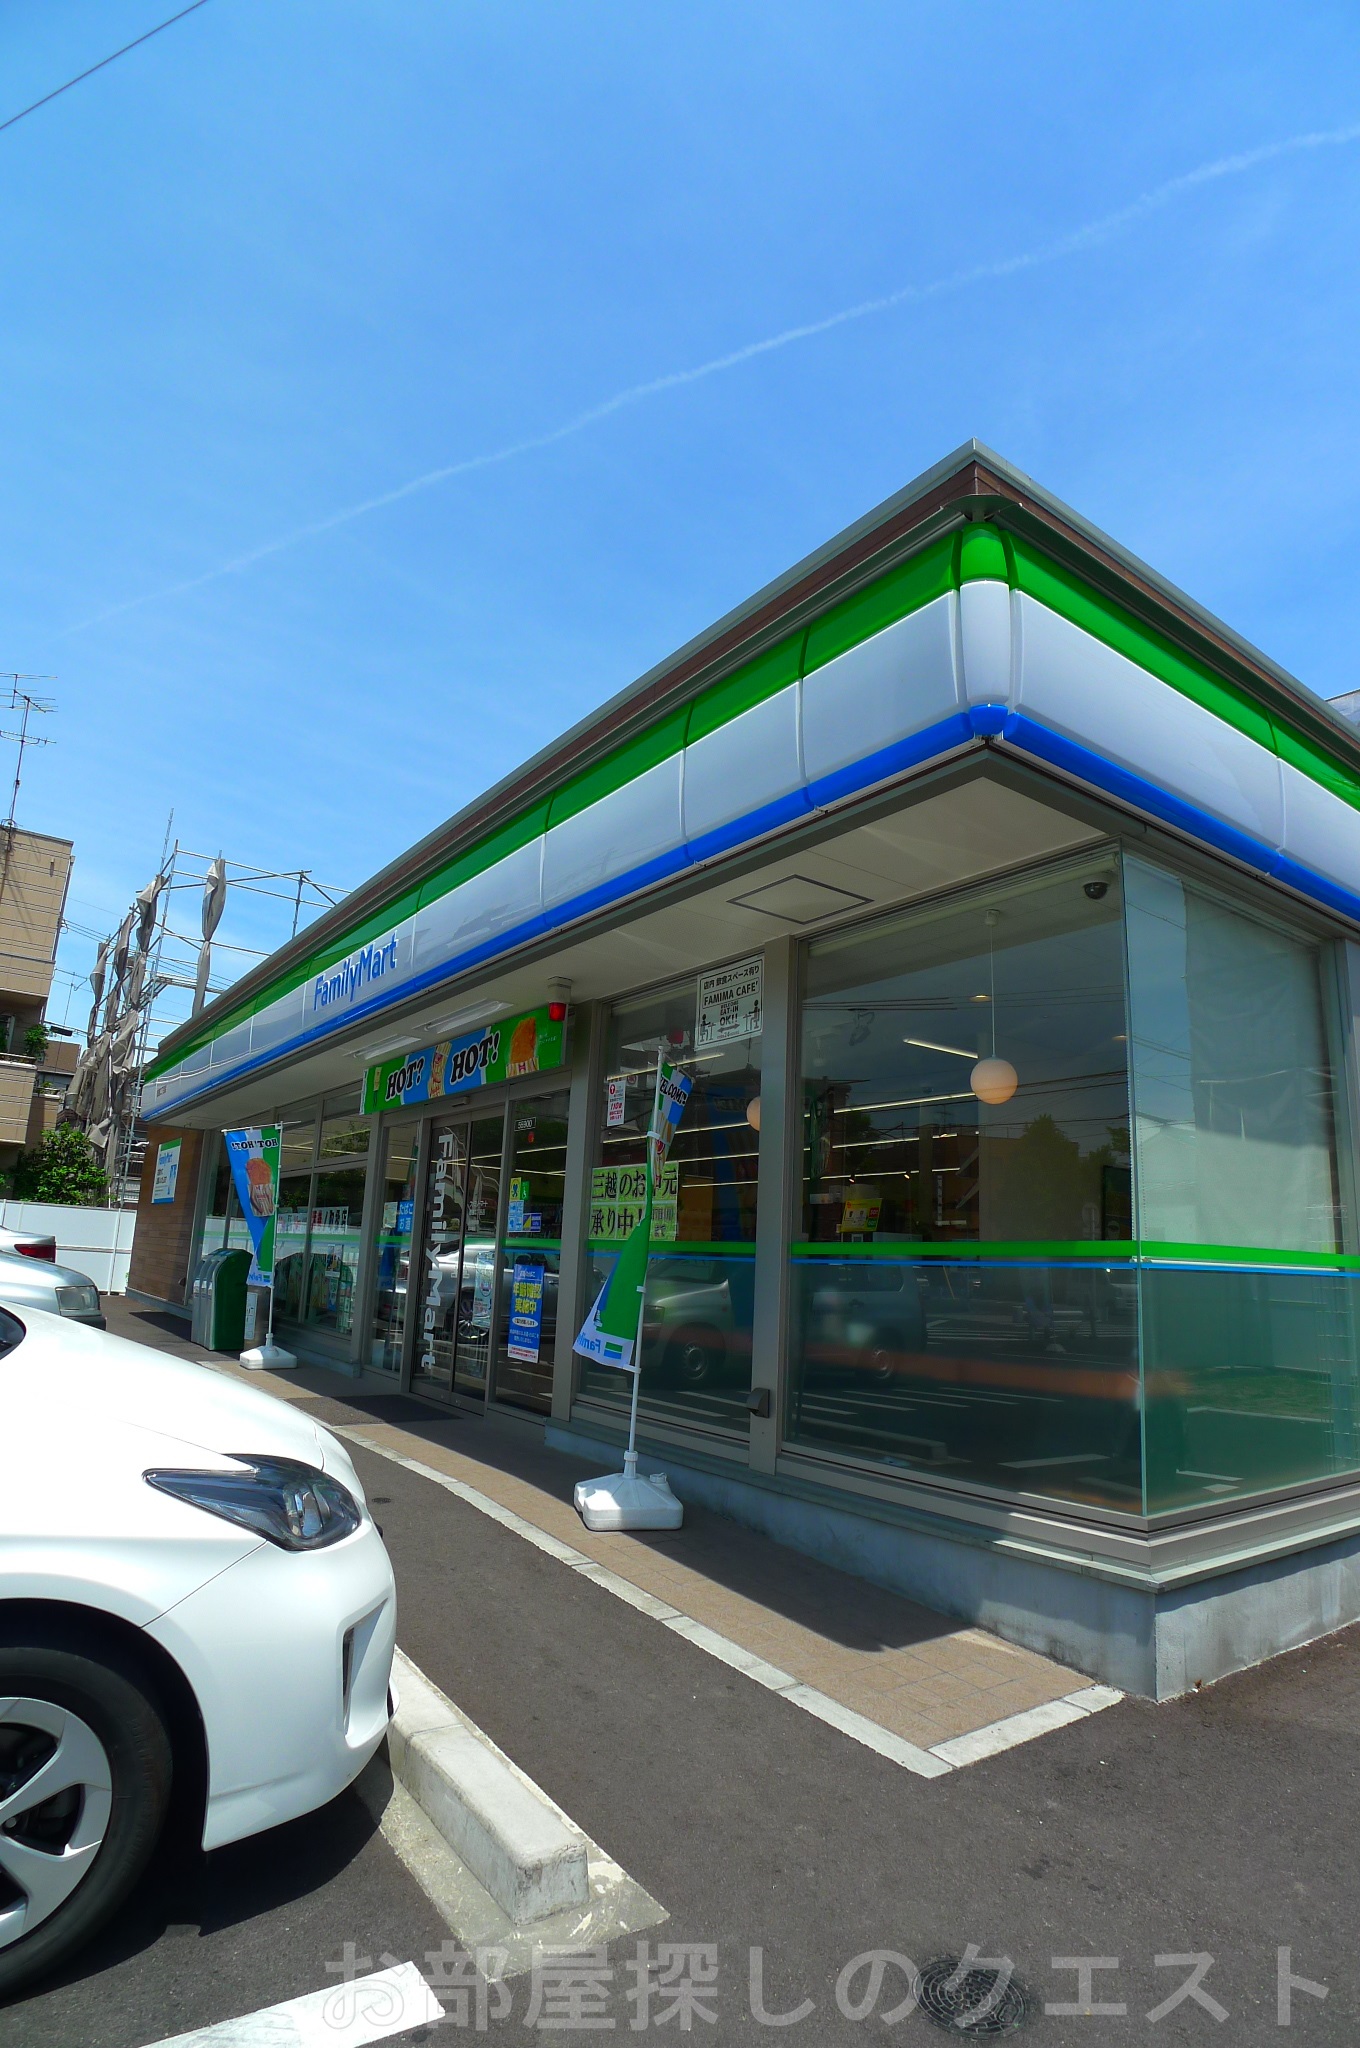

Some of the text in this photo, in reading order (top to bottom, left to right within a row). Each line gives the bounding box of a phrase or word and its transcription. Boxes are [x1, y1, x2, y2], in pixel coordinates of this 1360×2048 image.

[313, 930, 399, 1011] FamilyMart
[704, 989, 734, 1006] FAMIMA
[720, 1005, 739, 1016] EAT-IN
[720, 1013, 738, 1026] OK!!
[385, 1031, 501, 1101] HOT? HOT!
[421, 1134, 453, 1369] FamilyMart
